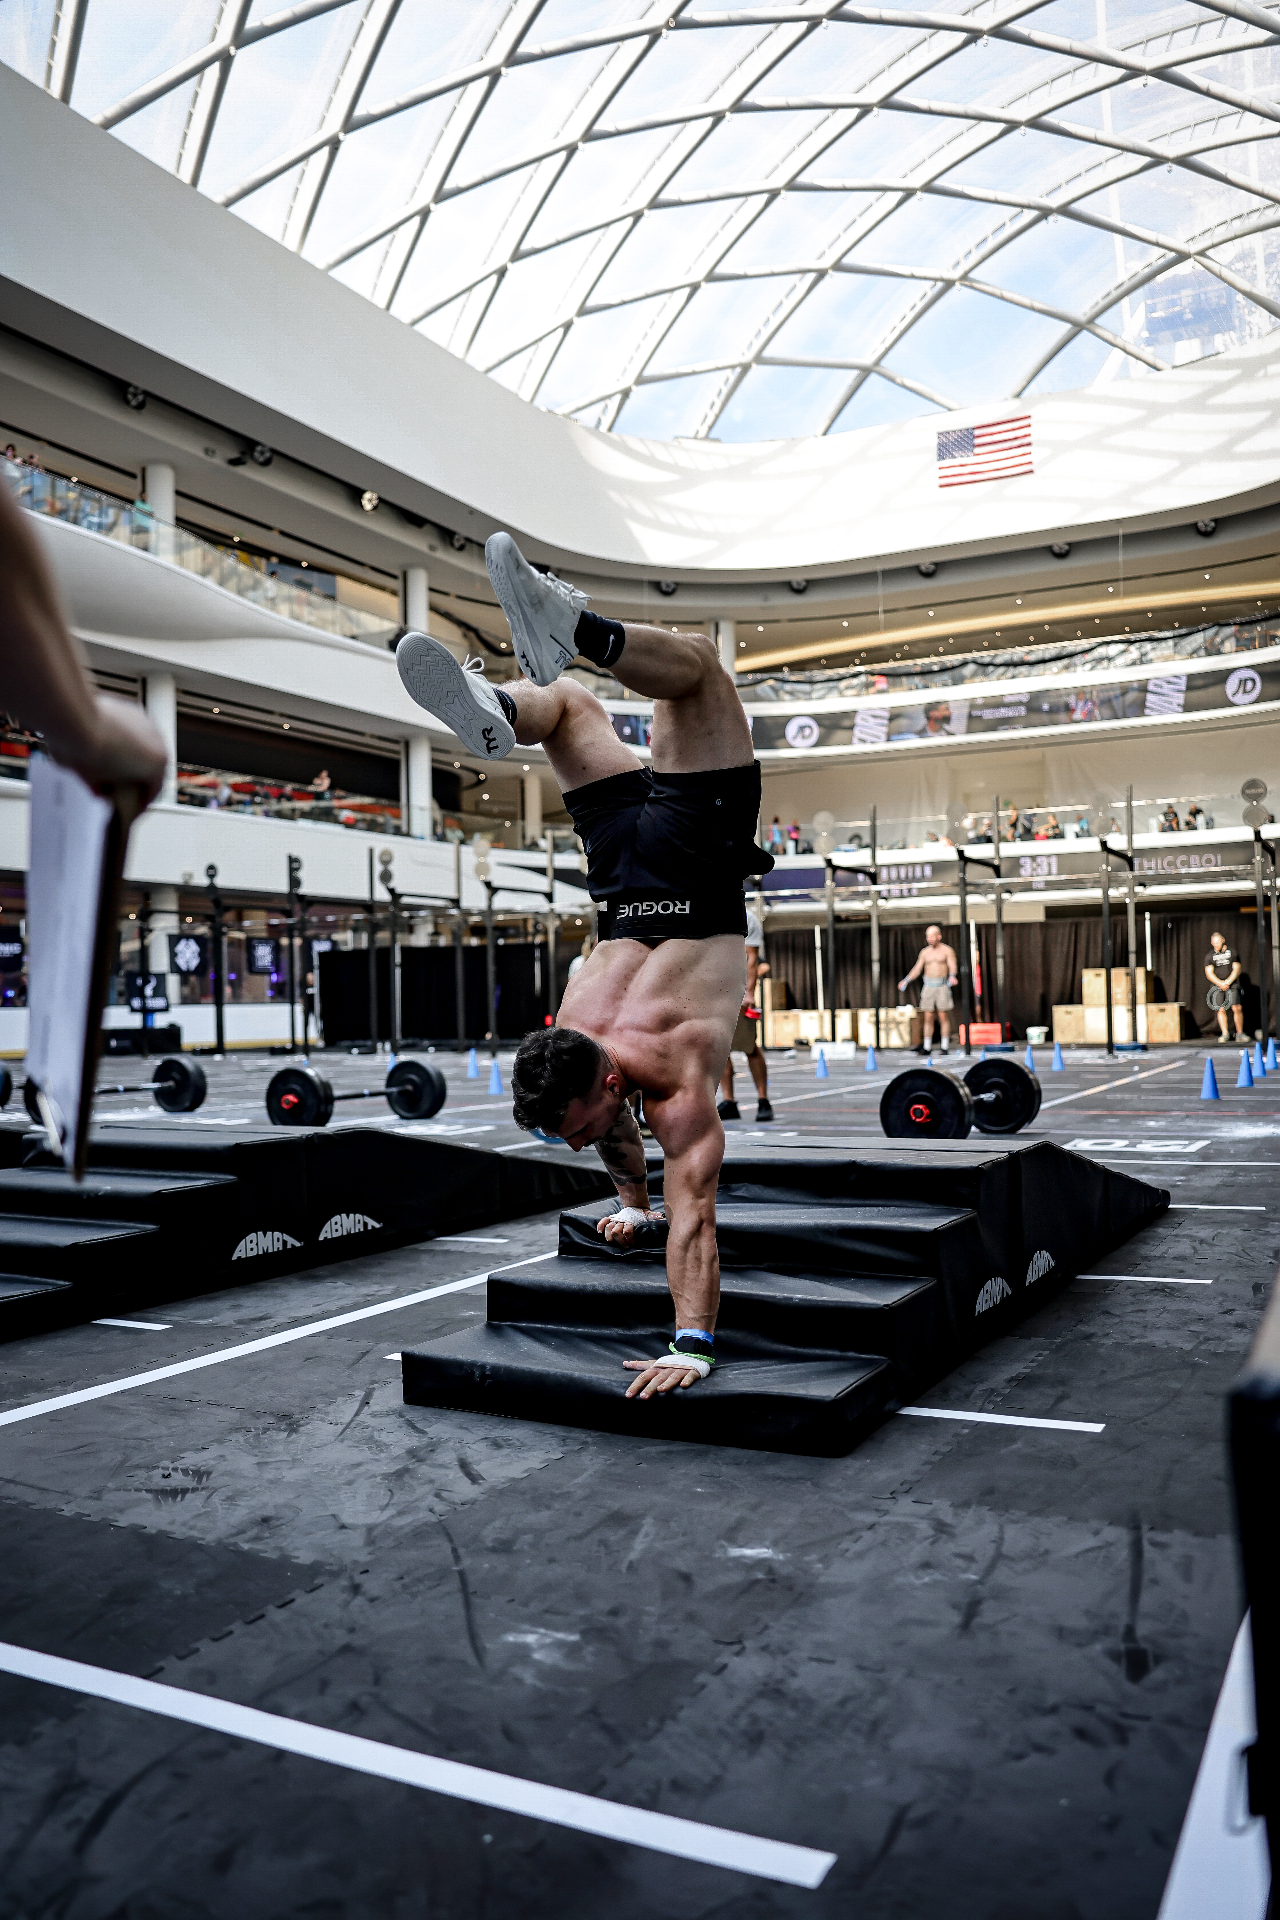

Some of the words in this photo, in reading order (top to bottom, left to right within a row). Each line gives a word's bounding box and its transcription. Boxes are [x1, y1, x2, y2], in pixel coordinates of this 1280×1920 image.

[481, 725, 499, 754] TYR
[616, 900, 691, 920] ROGUE
[318, 1213, 382, 1241] ABMAT
[231, 1231, 302, 1261] ABMAT
